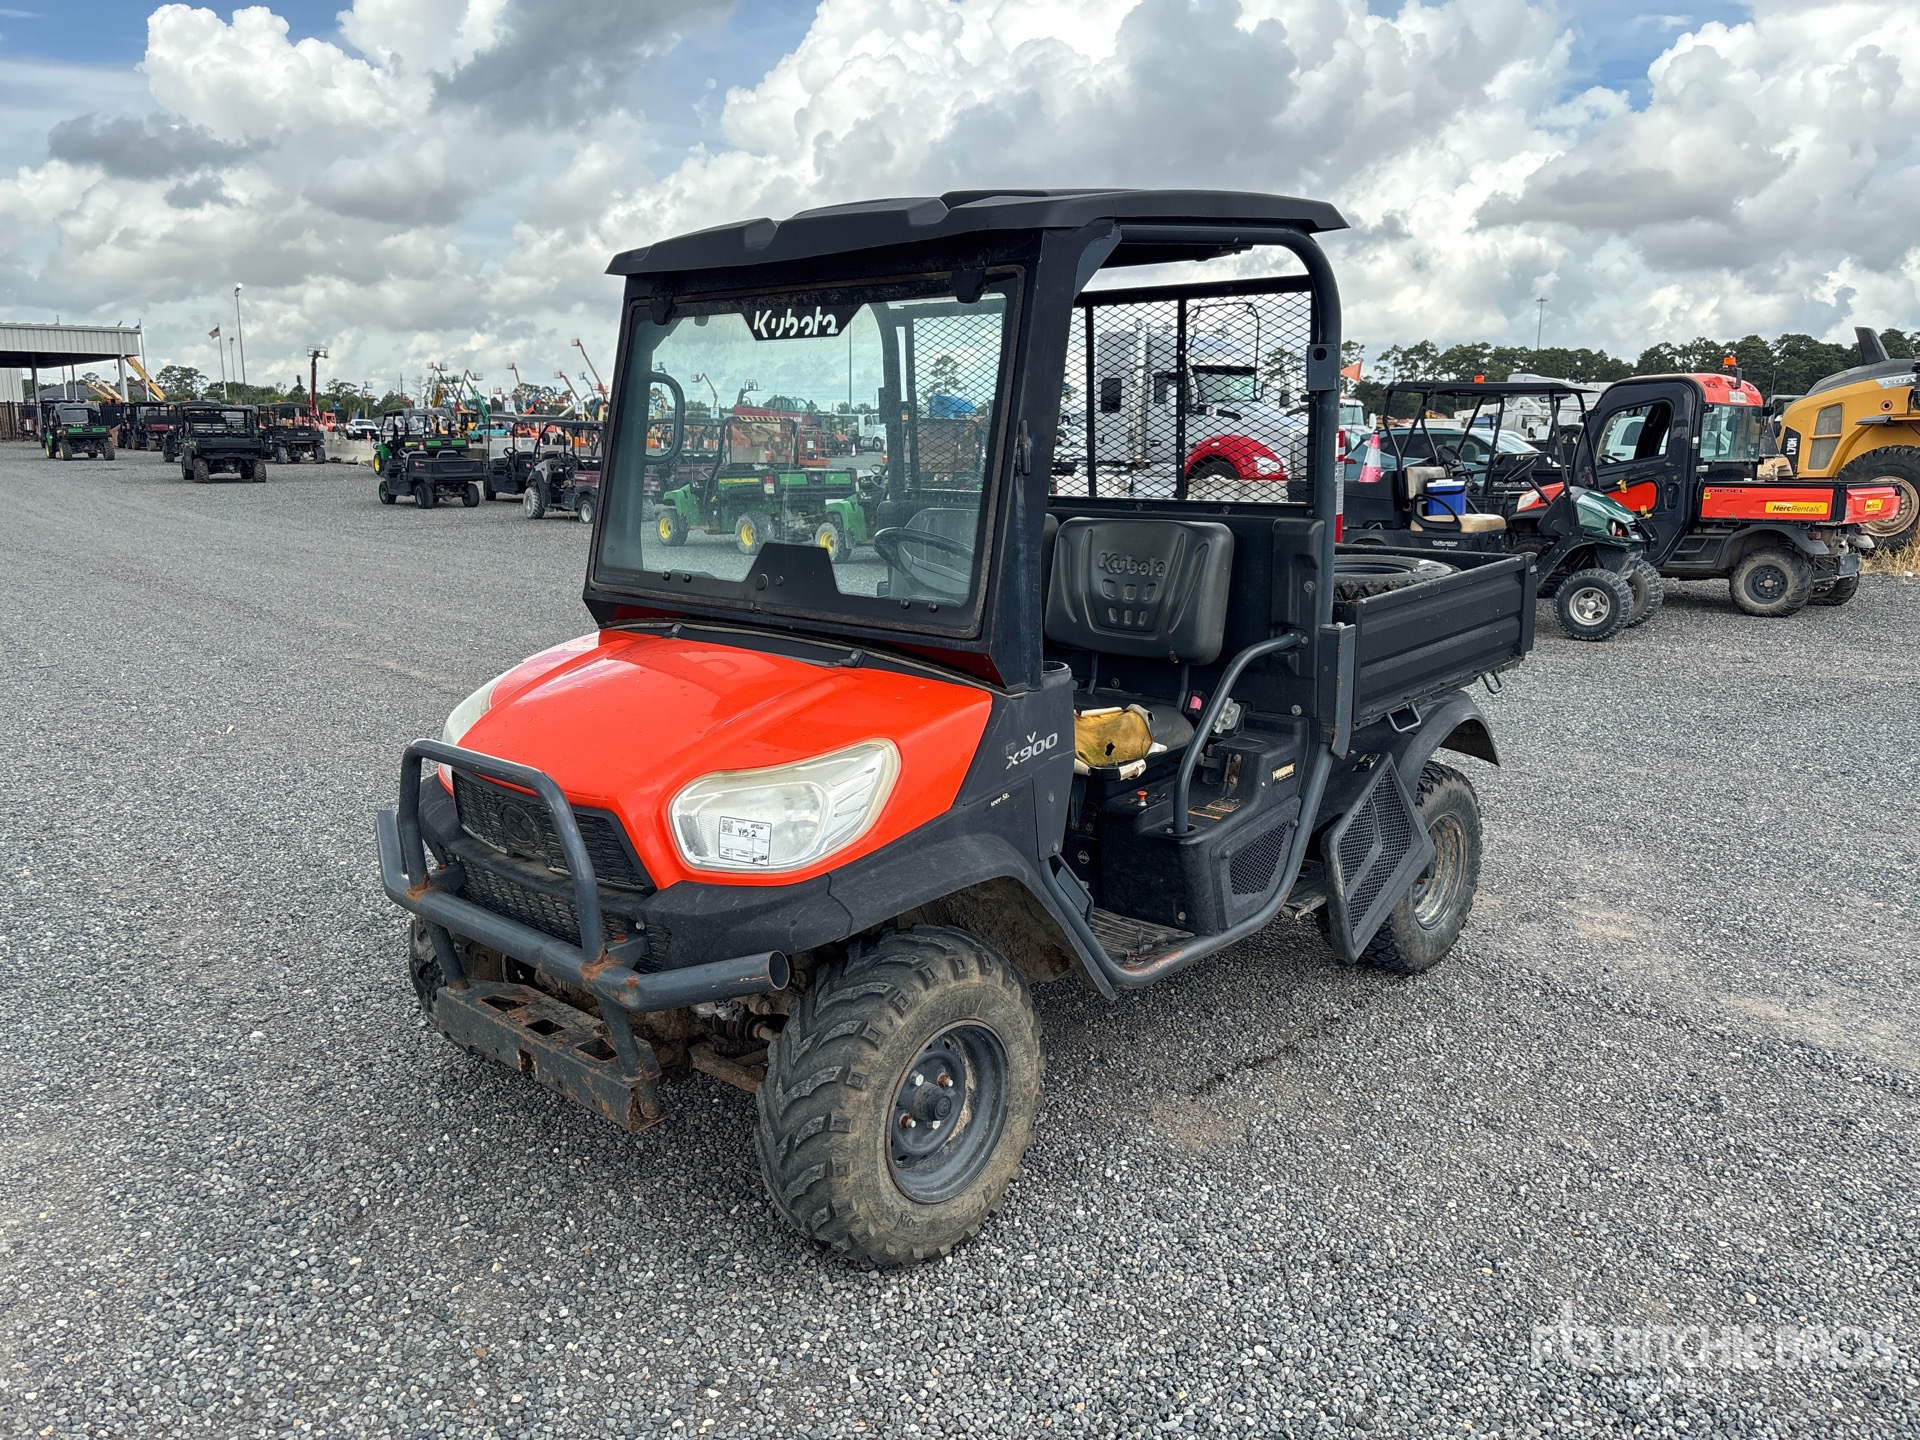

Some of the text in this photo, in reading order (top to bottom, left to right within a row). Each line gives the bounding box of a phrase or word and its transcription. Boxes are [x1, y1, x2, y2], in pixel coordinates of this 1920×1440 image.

[754, 306, 838, 338] Kubota
[1786, 437, 1798, 455] L70H
[1773, 504, 1821, 513] HercRentals
[1099, 552, 1166, 577] Kubota
[1005, 733, 1058, 770] X900
